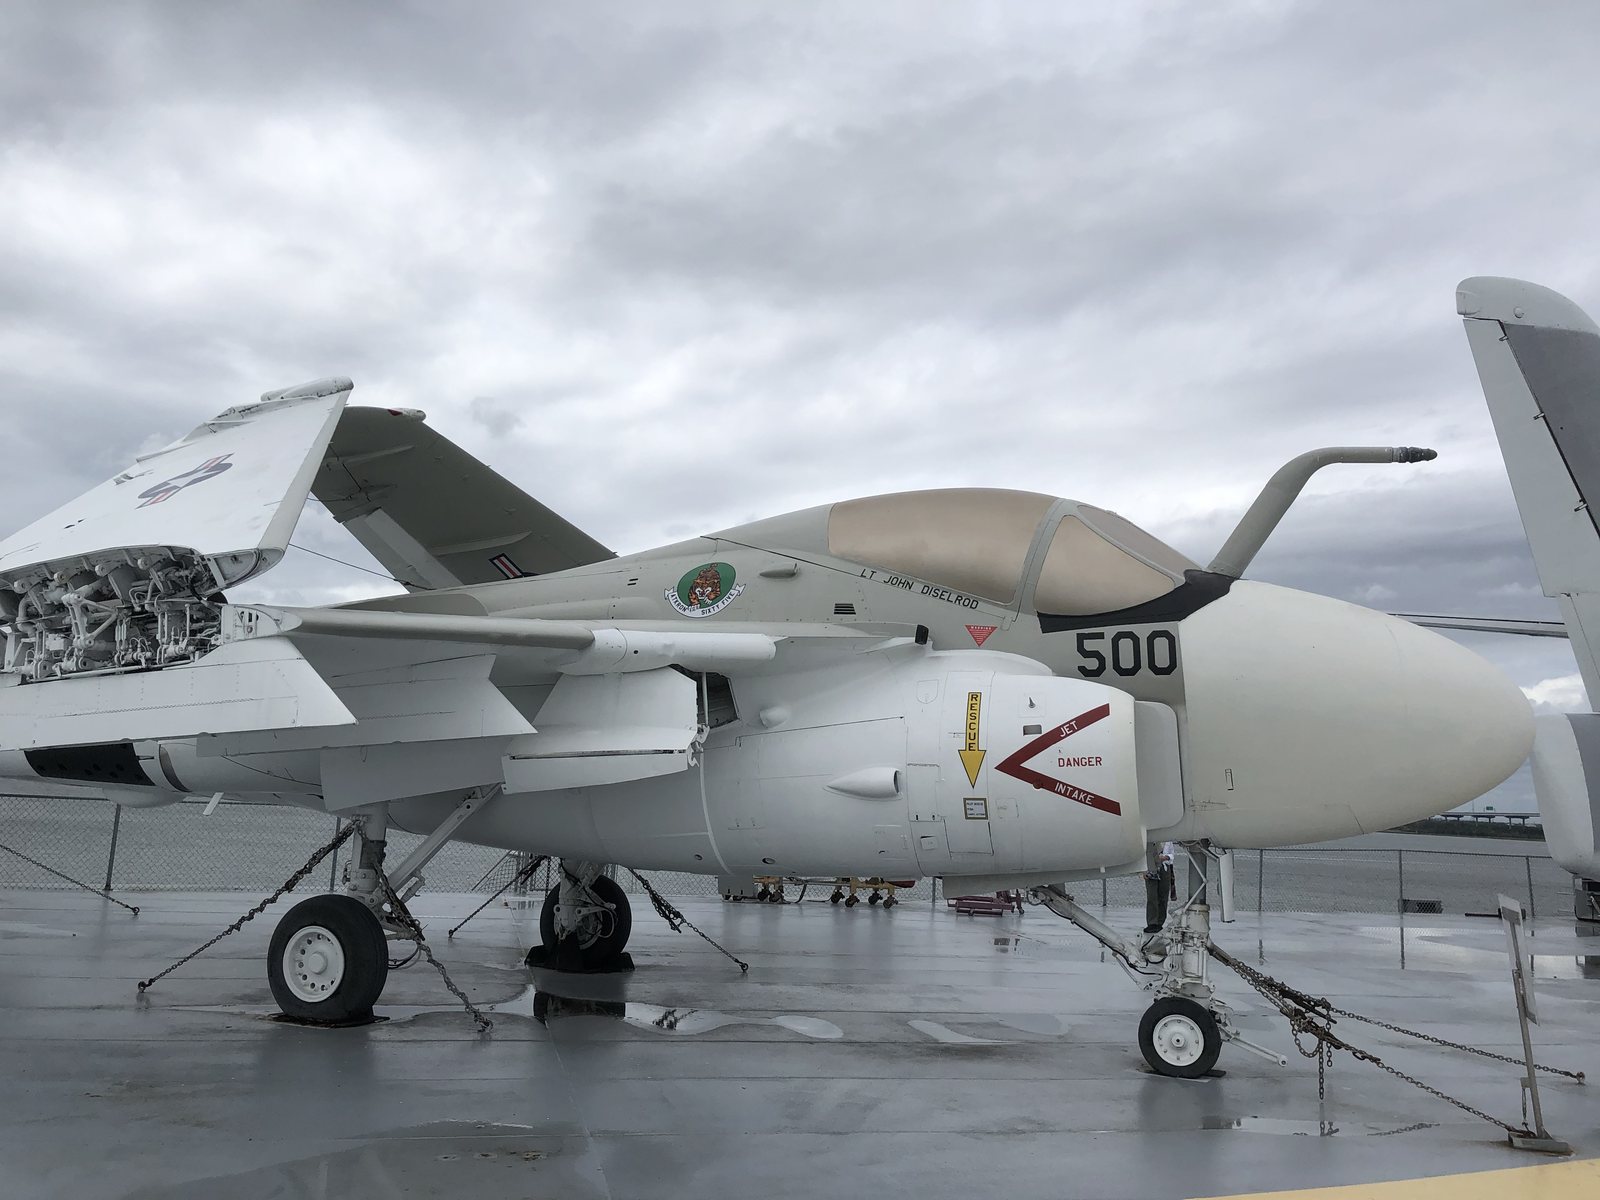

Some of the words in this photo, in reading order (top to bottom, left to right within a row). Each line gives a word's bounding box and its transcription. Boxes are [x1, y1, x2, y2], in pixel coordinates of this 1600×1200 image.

[860, 568, 877, 580] LT
[883, 575, 914, 591] JOHN
[920, 585, 979, 610] DISELROD
[701, 604, 720, 616] SIXTY
[722, 592, 735, 606] FIVE
[1076, 629, 1178, 678] 500
[967, 693, 979, 752] RESCUE
[1059, 720, 1078, 738] JET
[1058, 756, 1103, 768] DANGER
[1054, 782, 1095, 806] INTAKE
